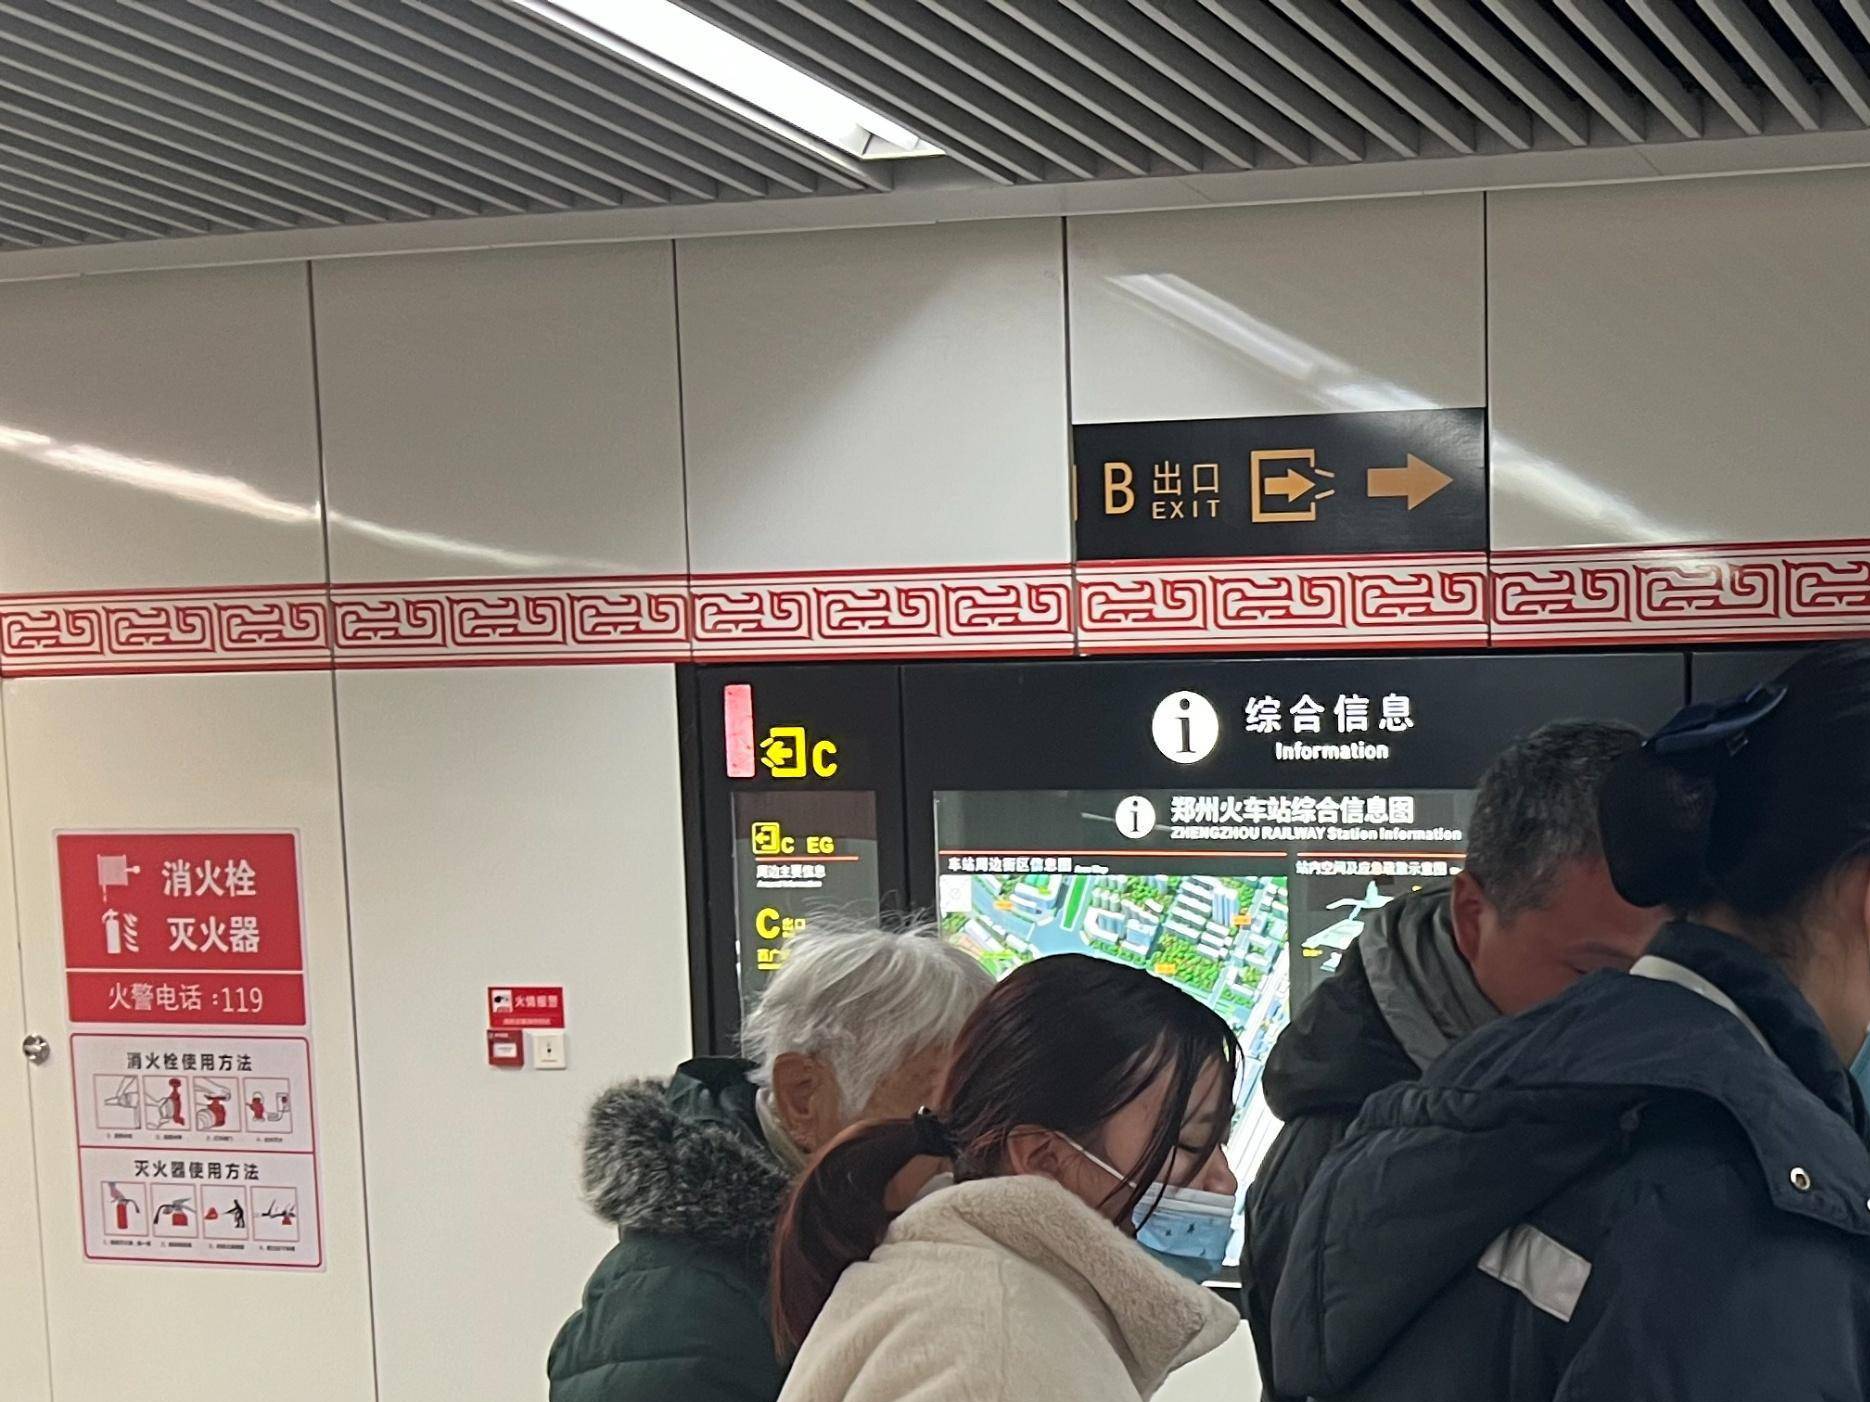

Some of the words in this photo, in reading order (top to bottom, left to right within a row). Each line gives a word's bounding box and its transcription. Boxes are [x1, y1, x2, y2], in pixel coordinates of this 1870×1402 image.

[1103, 462, 1135, 515] B
[1153, 460, 1220, 496] 出口
[1151, 499, 1221, 520] EXIT
[1244, 693, 1415, 734] 综合信息
[812, 740, 838, 777] C
[1275, 741, 1389, 761] Information
[1170, 795, 1415, 824] 郑州火车站综合信息图
[806, 836, 835, 854] EG
[1170, 826, 1260, 840] ZHENGZHOU
[1261, 827, 1326, 841] RAILWAY
[1326, 827, 1377, 841] Station
[1379, 827, 1463, 841] Information
[161, 859, 257, 897] 消火栓
[166, 915, 260, 953] 灭火器
[755, 907, 781, 939] C
[127, 1051, 254, 1072] 消火栓使用方法
[134, 1160, 261, 1181] 灭火器使用方法
